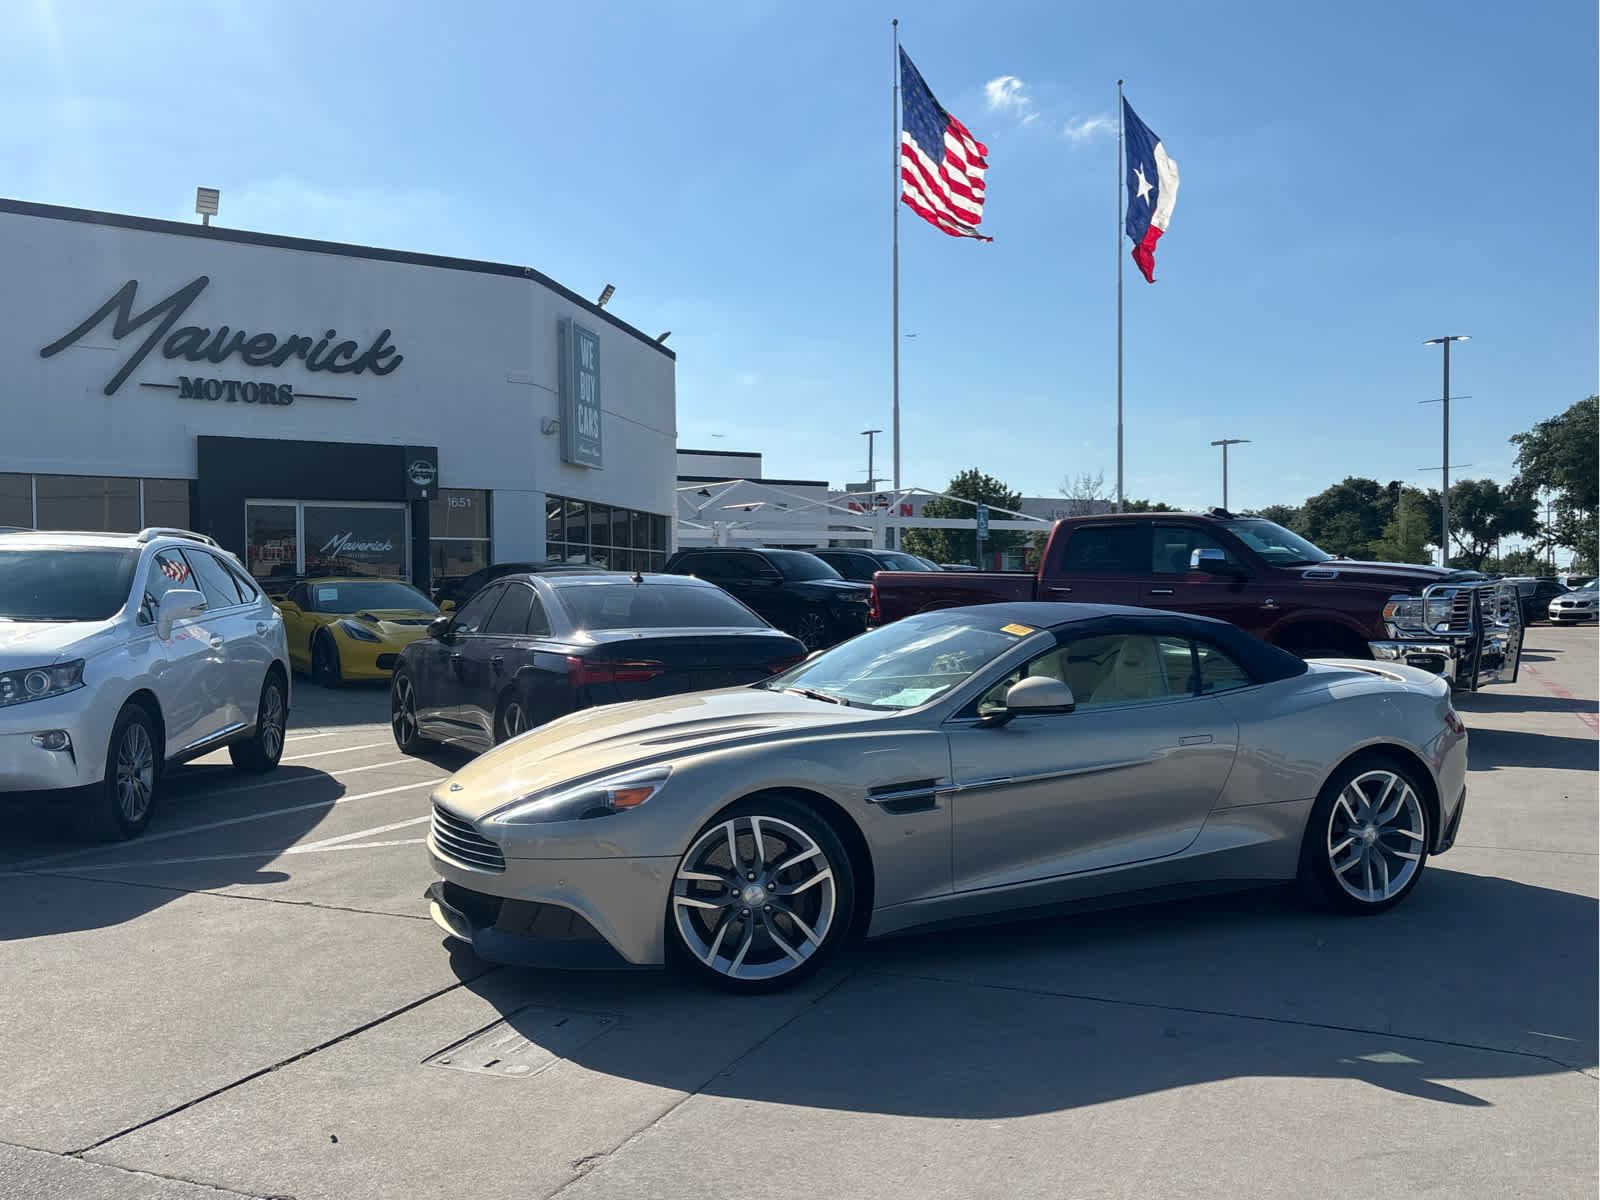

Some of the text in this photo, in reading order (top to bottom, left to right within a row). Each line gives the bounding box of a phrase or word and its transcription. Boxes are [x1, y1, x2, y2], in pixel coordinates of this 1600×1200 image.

[40, 275, 403, 395] Maverick
[580, 336, 594, 370] WE
[178, 376, 294, 406] MOTORS
[580, 371, 595, 402] BUY
[578, 404, 598, 438] CARS
[320, 531, 393, 558] Maverick
